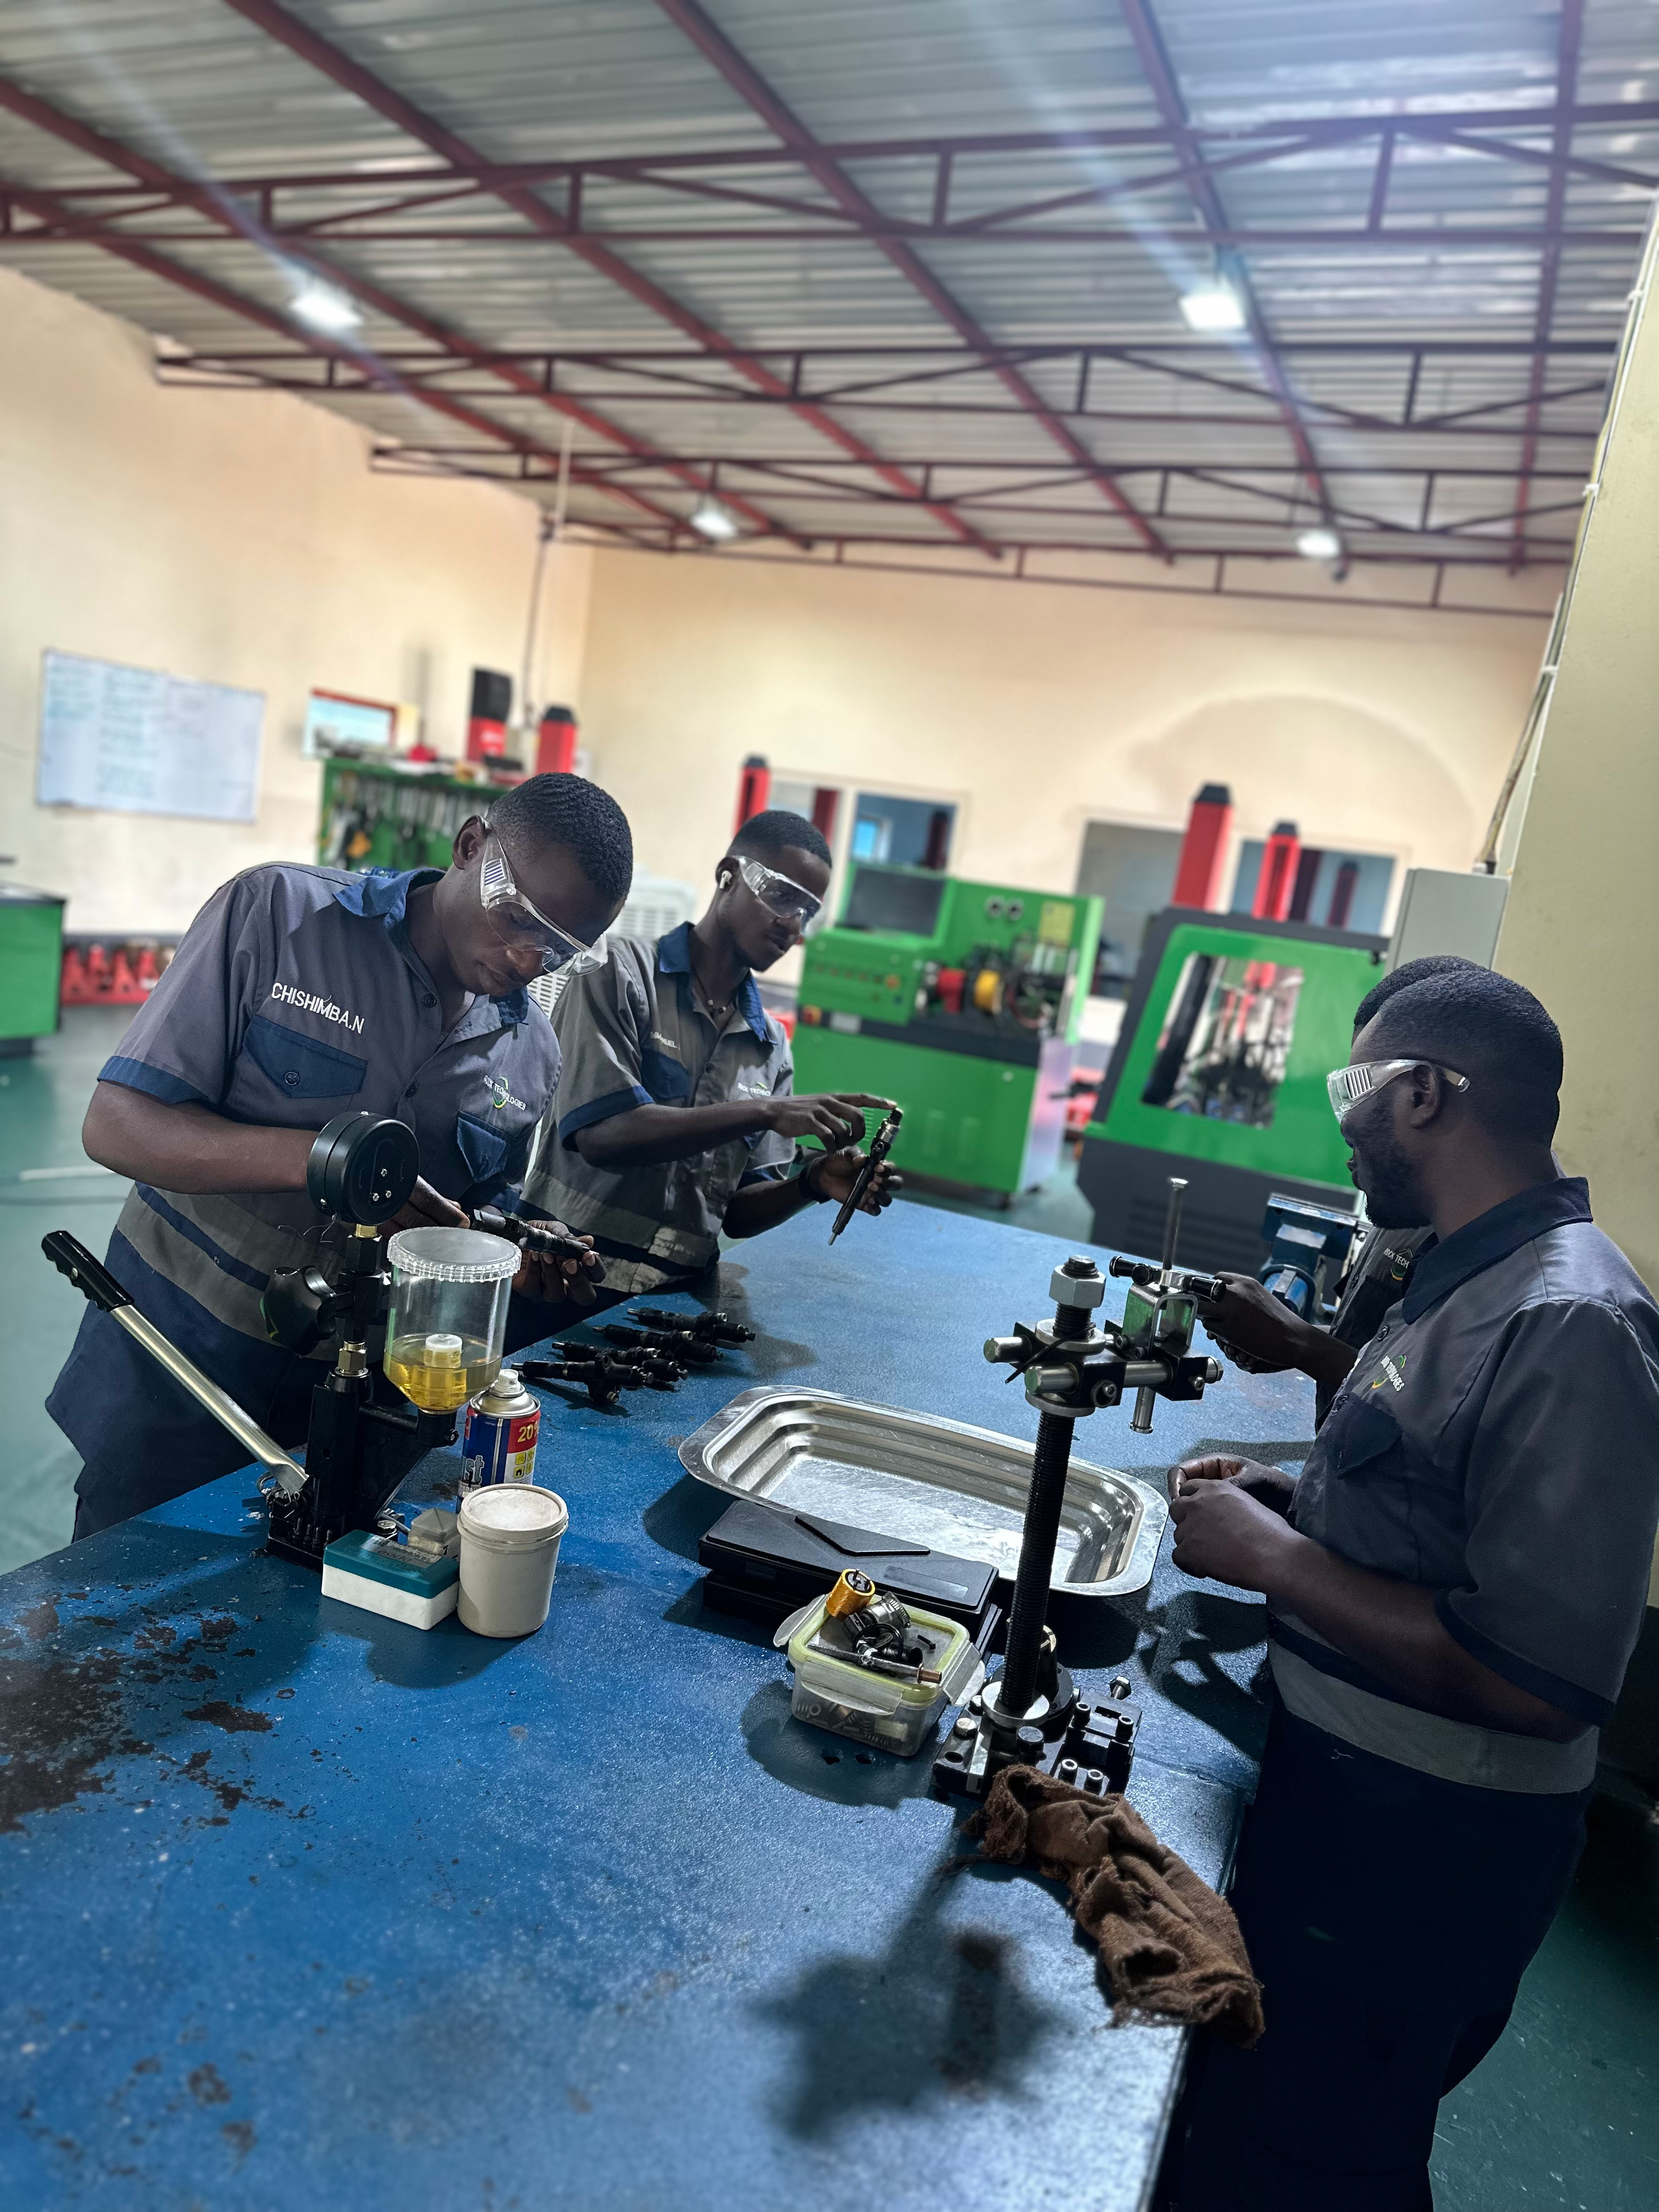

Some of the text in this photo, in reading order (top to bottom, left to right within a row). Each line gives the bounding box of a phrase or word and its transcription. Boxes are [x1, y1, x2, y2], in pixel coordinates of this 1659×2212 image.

[272, 982, 365, 1034] CHISHIMBA.N
[494, 1083, 526, 1111] TECHNOLOGIES
[749, 1087, 771, 1096] TECHNO
[1395, 1254, 1410, 1268] TECH
[462, 1455, 485, 1485] st
[377, 1550, 413, 1562] DENSO
